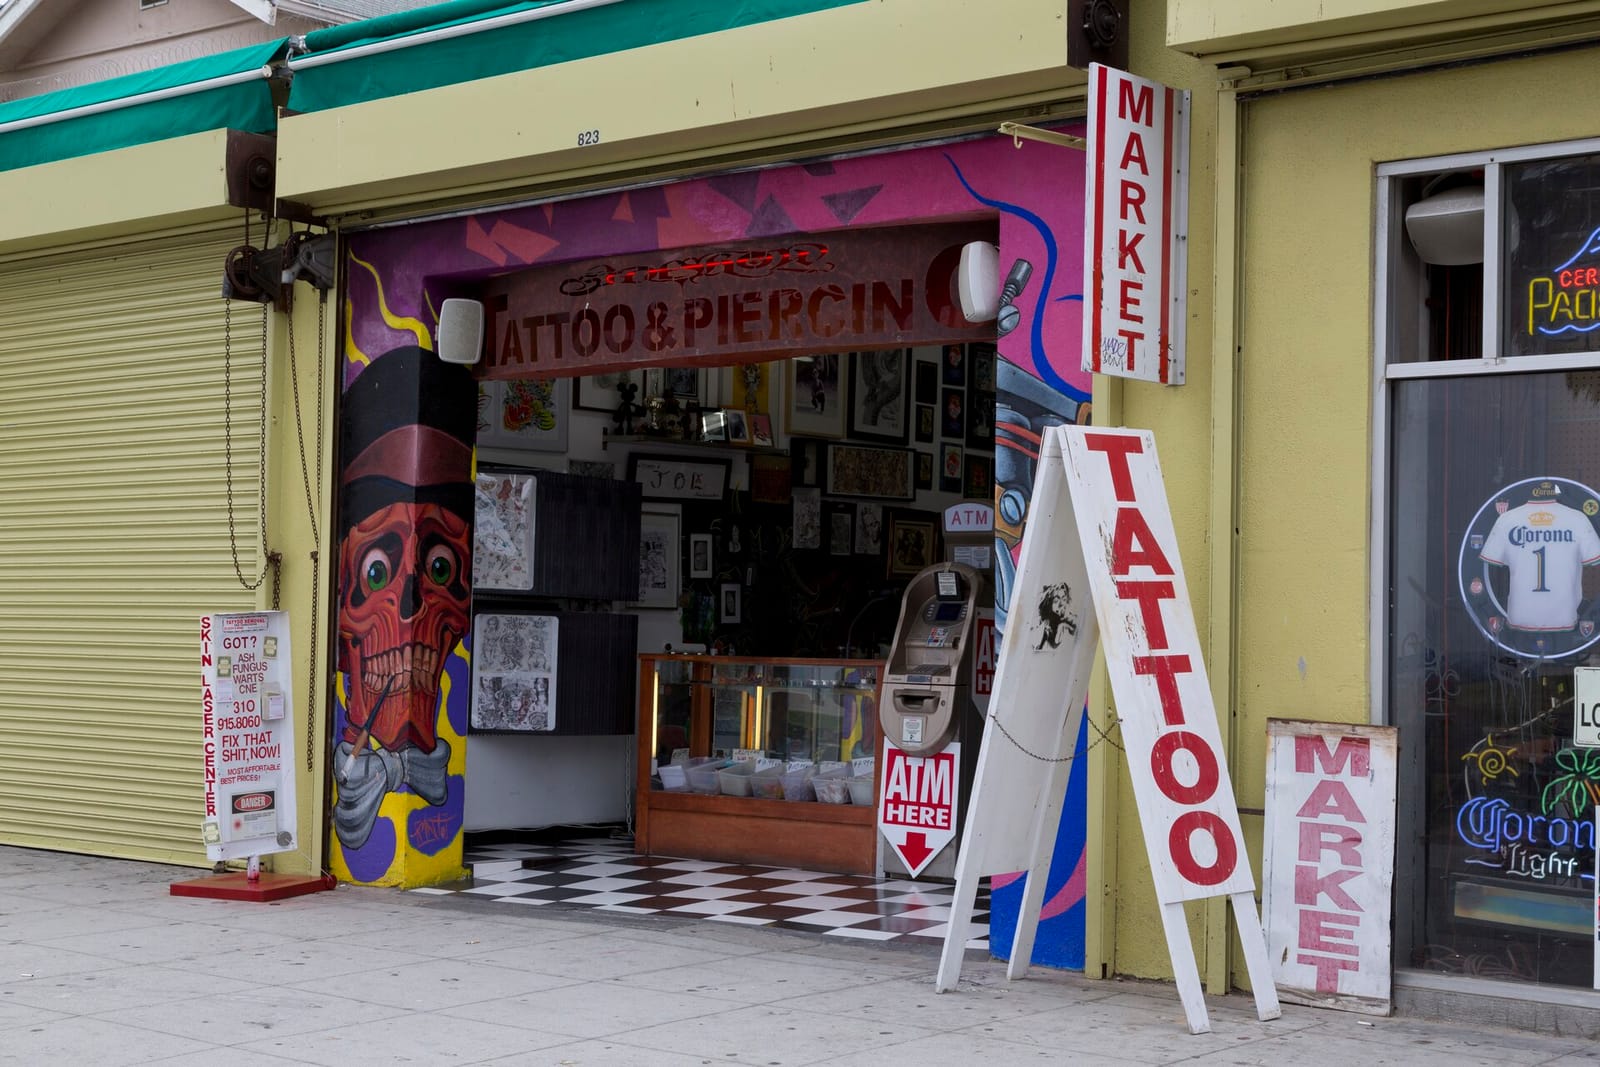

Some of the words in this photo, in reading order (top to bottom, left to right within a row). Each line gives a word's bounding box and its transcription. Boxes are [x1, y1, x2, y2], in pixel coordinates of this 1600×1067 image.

[578, 129, 600, 146] 823
[1118, 78, 1154, 371] MARKET
[1528, 277, 1600, 336] PACI
[485, 294, 635, 367] TATTOO
[642, 301, 677, 351] &
[1532, 487, 1560, 497] Coron
[951, 510, 988, 525] ATM
[1508, 525, 1573, 548] Corona
[1532, 546, 1551, 592] 1
[201, 616, 212, 667] SKIN
[223, 635, 257, 650] GOT?
[232, 662, 268, 674] FUNGUS
[238, 653, 255, 663] ASH
[1085, 432, 1238, 886] TATTOO
[233, 673, 264, 684] WARTS
[239, 684, 257, 695] CNE
[202, 675, 214, 739] LASER
[222, 735, 239, 748] FIX
[243, 731, 272, 746] THAT
[204, 743, 217, 816] CENTER
[220, 777, 236, 785] BEST
[227, 767, 244, 776] MOST
[886, 755, 951, 806] ATM
[240, 796, 266, 809] DANGER
[886, 803, 949, 828] HERE
[1457, 795, 1597, 854] Coron
[1294, 734, 1371, 993] MARKET
[1506, 843, 1579, 879] Light
